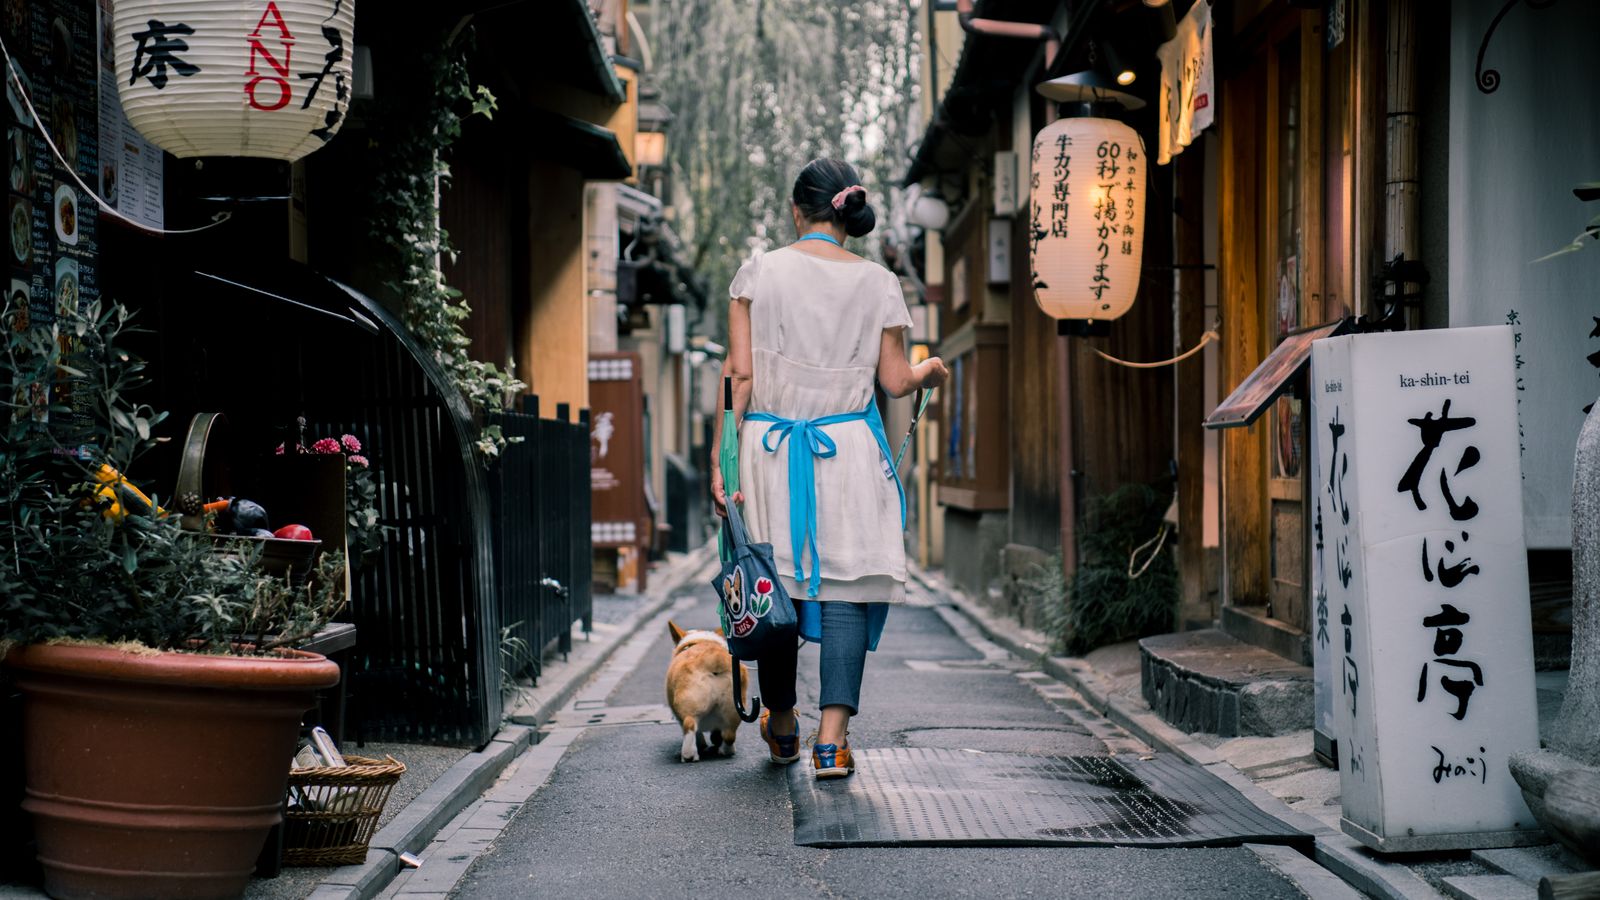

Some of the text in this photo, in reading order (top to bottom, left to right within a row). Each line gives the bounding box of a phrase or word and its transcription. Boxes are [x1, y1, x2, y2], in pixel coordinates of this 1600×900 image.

[130, 19, 201, 90] 床
[1050, 133, 1073, 240] 牛カツ専門店
[1089, 140, 1122, 311] 60秒で揚がります。
